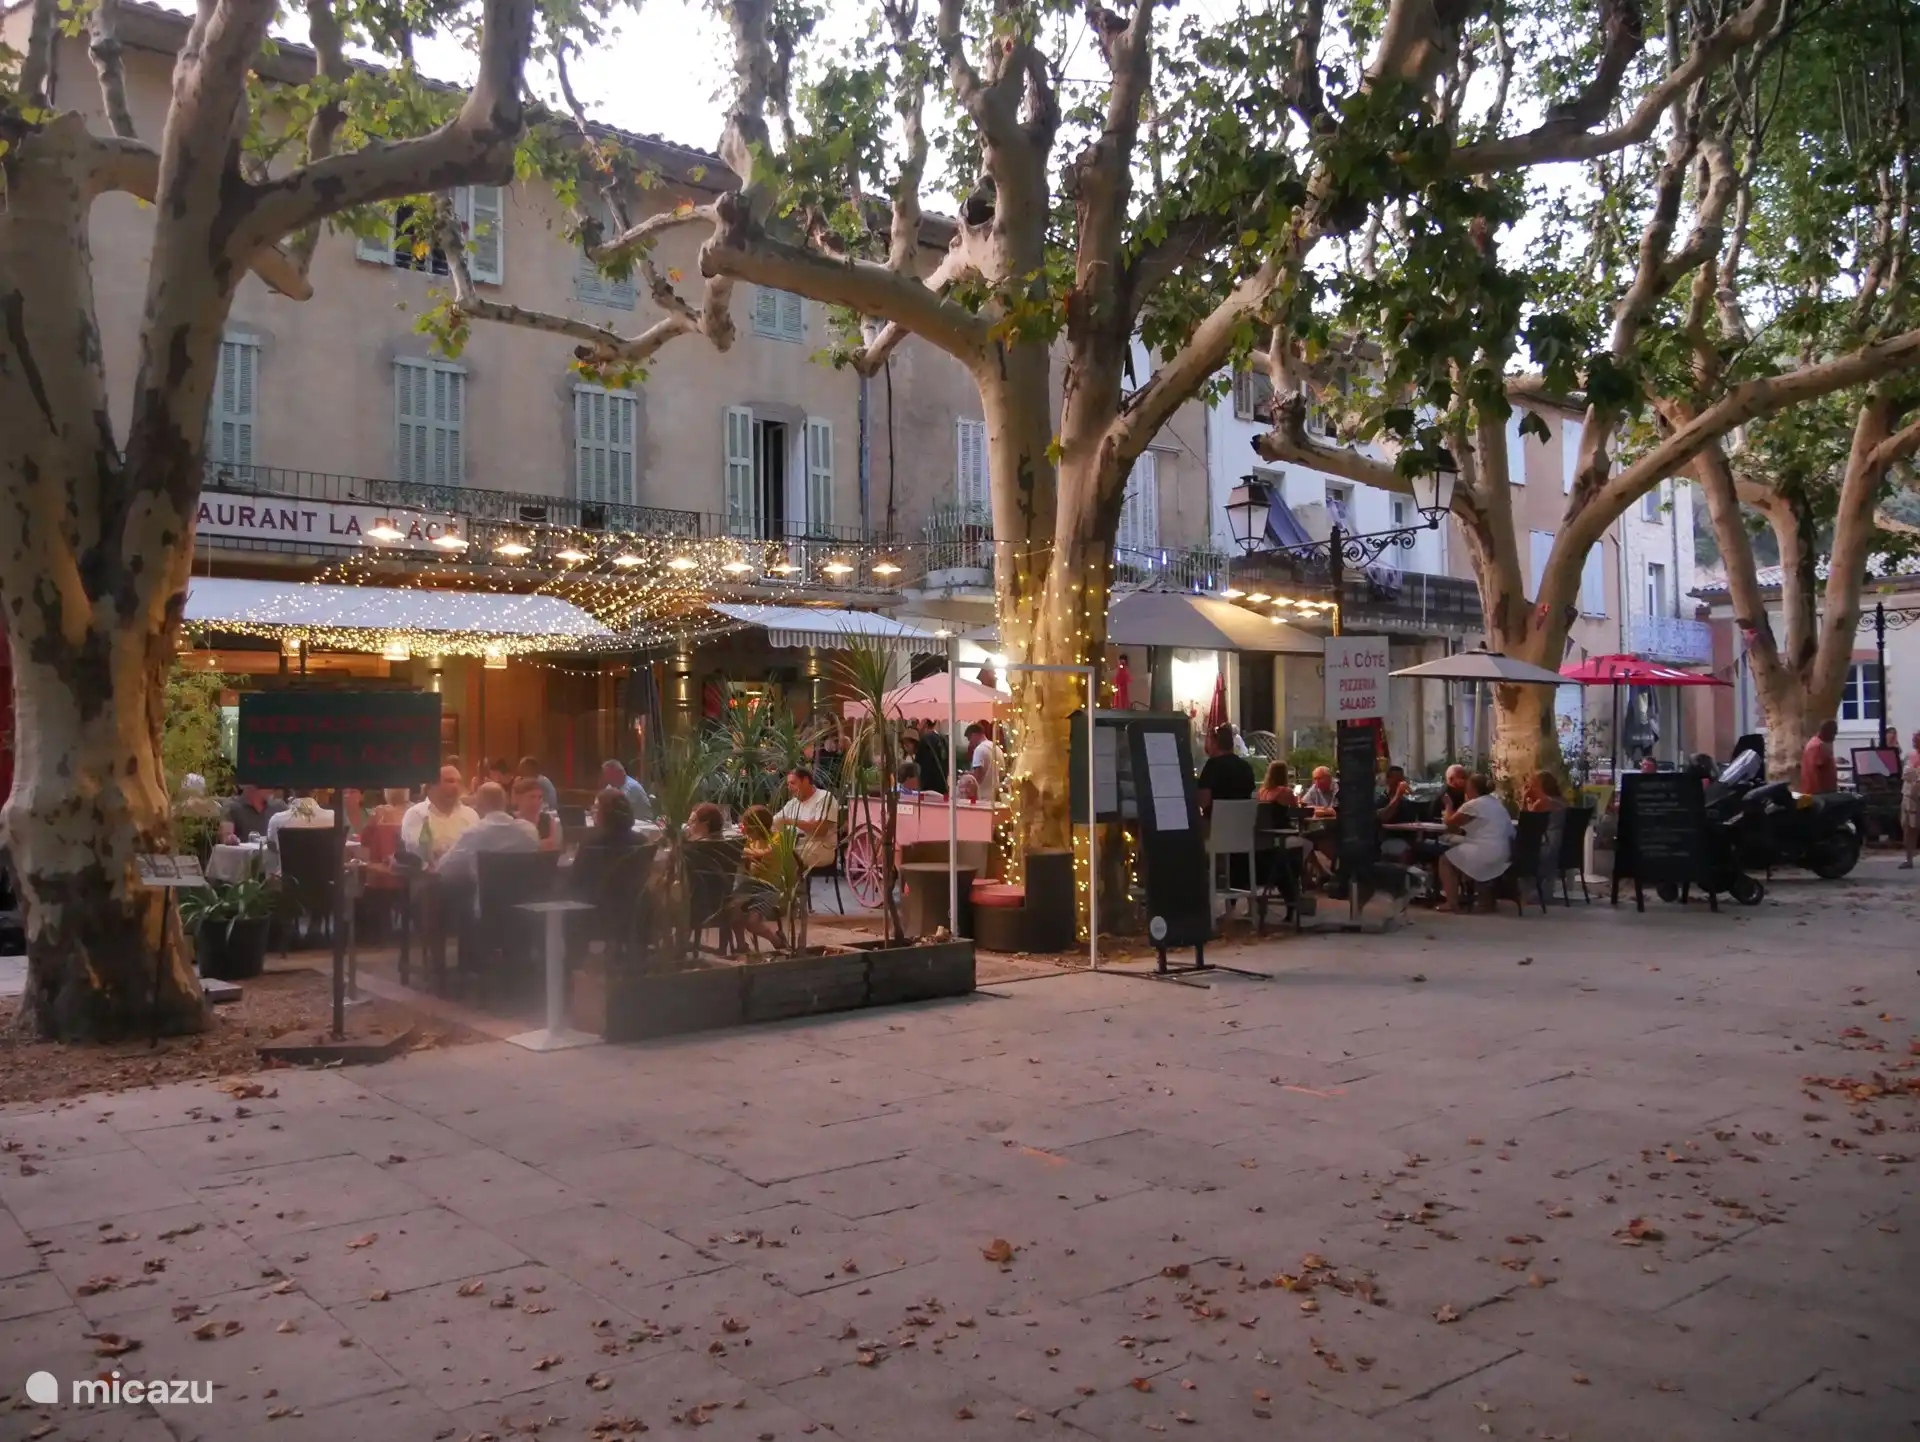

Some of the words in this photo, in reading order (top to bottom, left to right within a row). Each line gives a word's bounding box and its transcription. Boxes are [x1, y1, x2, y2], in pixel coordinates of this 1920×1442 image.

[329, 512, 362, 536] LA
[1354, 649, 1386, 668] CÔTÉ
[1339, 696, 1376, 711] SALADES
[248, 743, 294, 766] LA
[309, 742, 433, 767] PLACE
